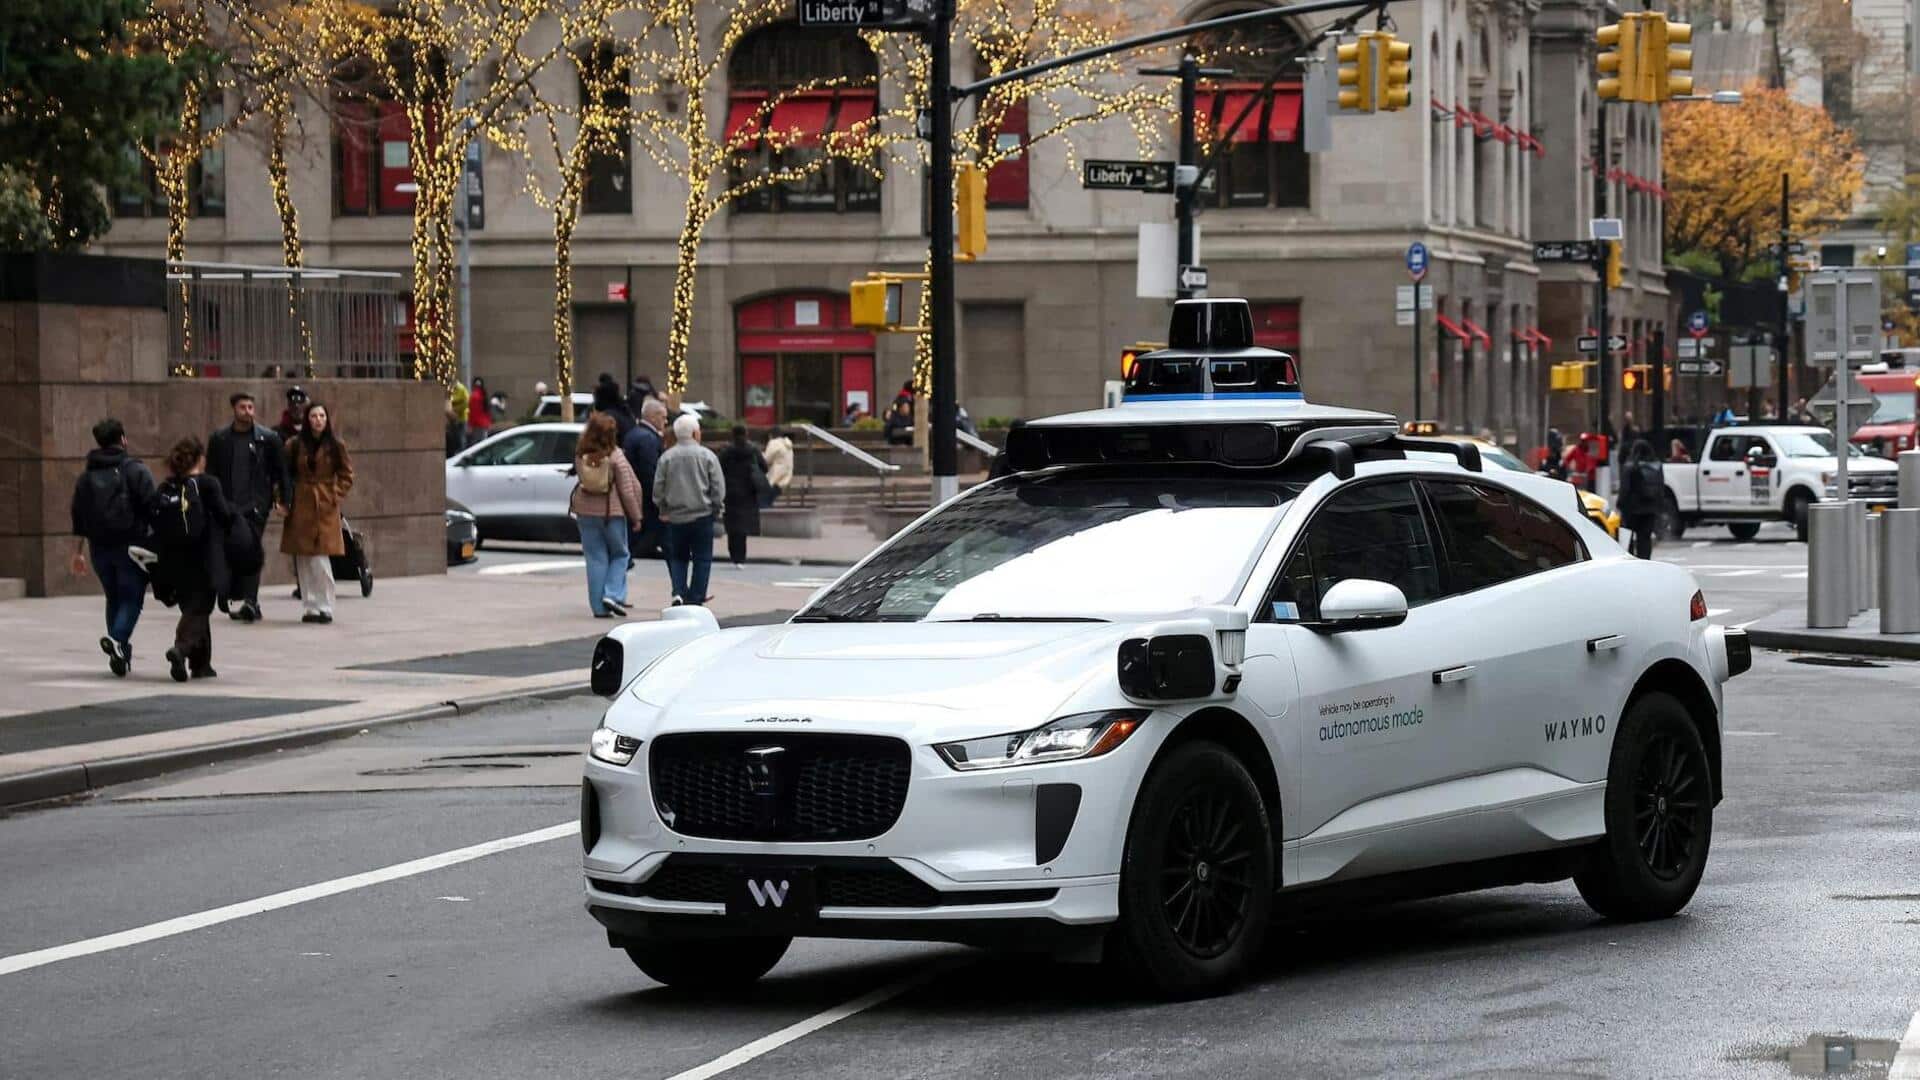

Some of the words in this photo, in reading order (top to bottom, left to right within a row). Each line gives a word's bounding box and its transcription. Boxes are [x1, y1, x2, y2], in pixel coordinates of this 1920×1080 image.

[805, 3, 865, 25] Liberty
[1090, 166, 1133, 186] Liberty
[1319, 703, 1339, 716] Vehicle
[1340, 702, 1352, 714] may
[1353, 699, 1361, 711] be
[1362, 695, 1389, 709] operating
[1319, 713, 1390, 741] autonomous
[1392, 703, 1424, 729] mode
[1544, 714, 1606, 742] WAYMO
